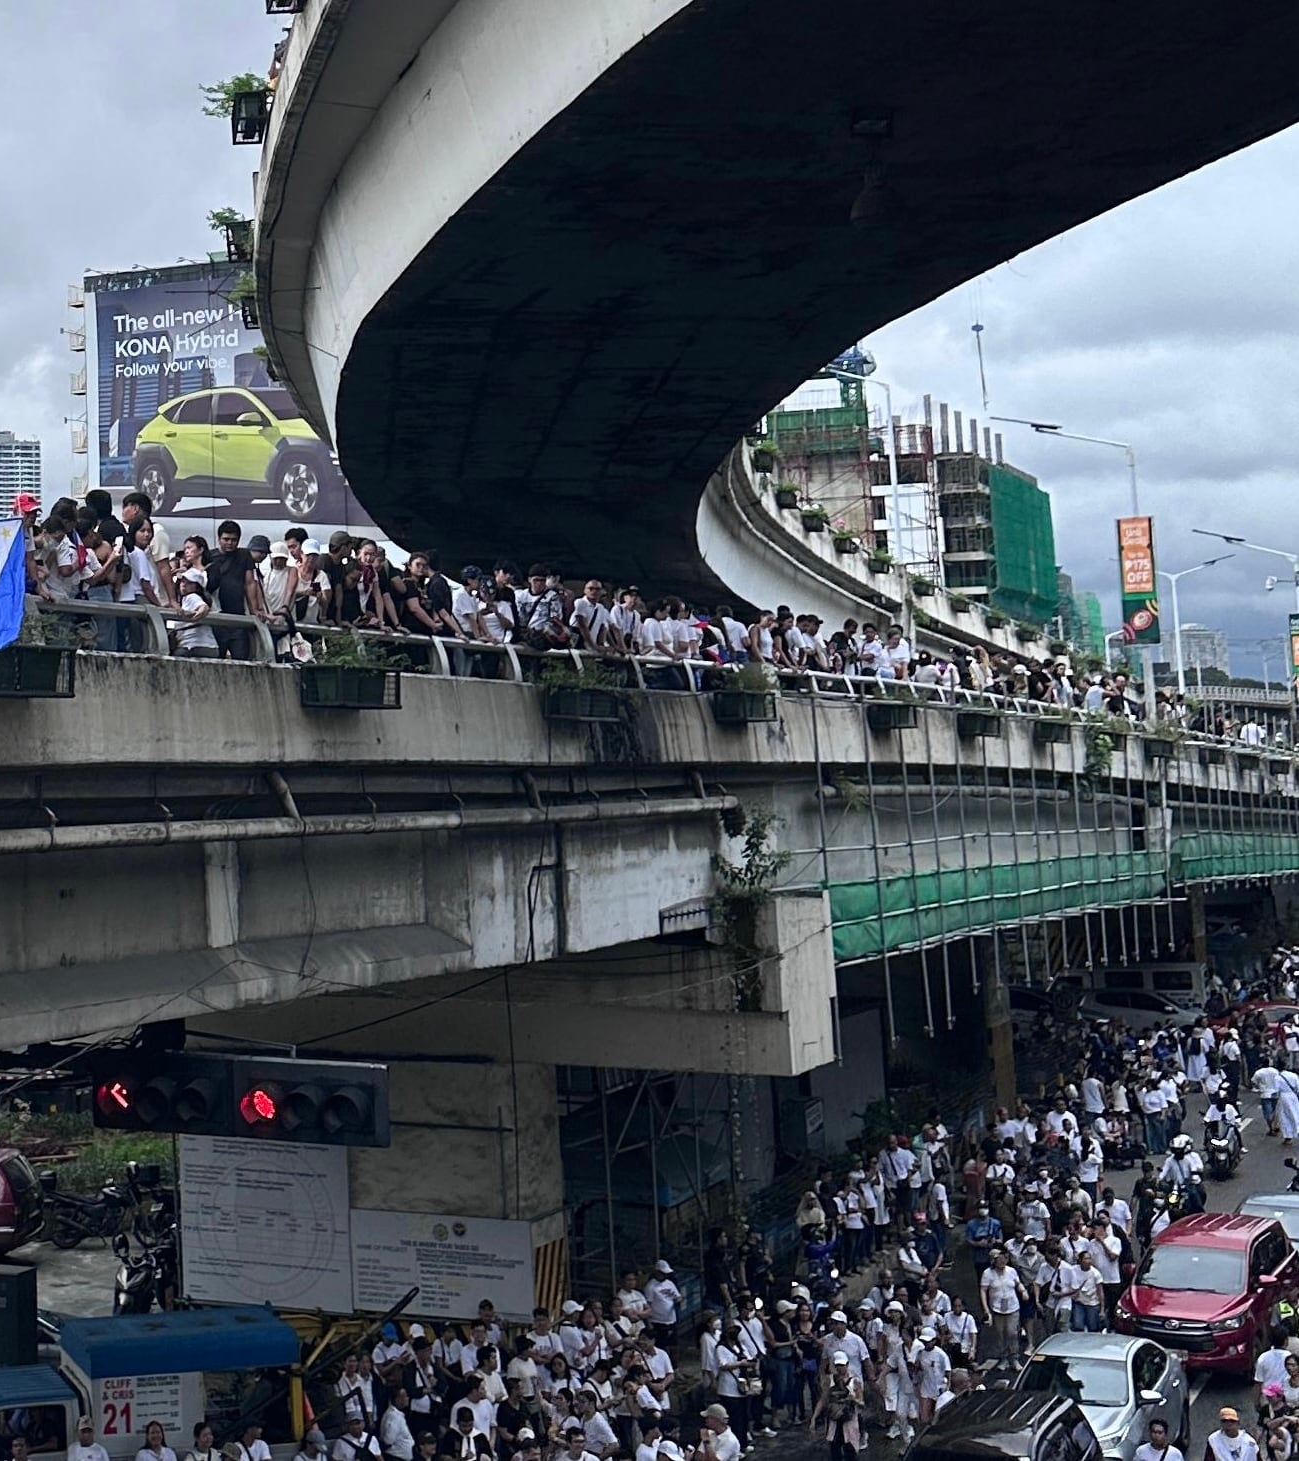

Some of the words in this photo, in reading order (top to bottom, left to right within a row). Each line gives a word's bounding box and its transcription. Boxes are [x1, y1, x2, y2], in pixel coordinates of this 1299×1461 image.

[113, 314, 148, 332] The
[153, 307, 223, 329] all-new
[116, 336, 171, 357] KONA
[176, 329, 239, 352] Hybrid
[116, 363, 159, 377] Follow
[163, 359, 193, 376] your
[197, 357, 231, 370] vibe.
[1127, 571, 1150, 583] OFF
[104, 1378, 132, 1389] CLIFF
[112, 1390, 134, 1400] CRIS
[103, 1402, 131, 1435] 21
